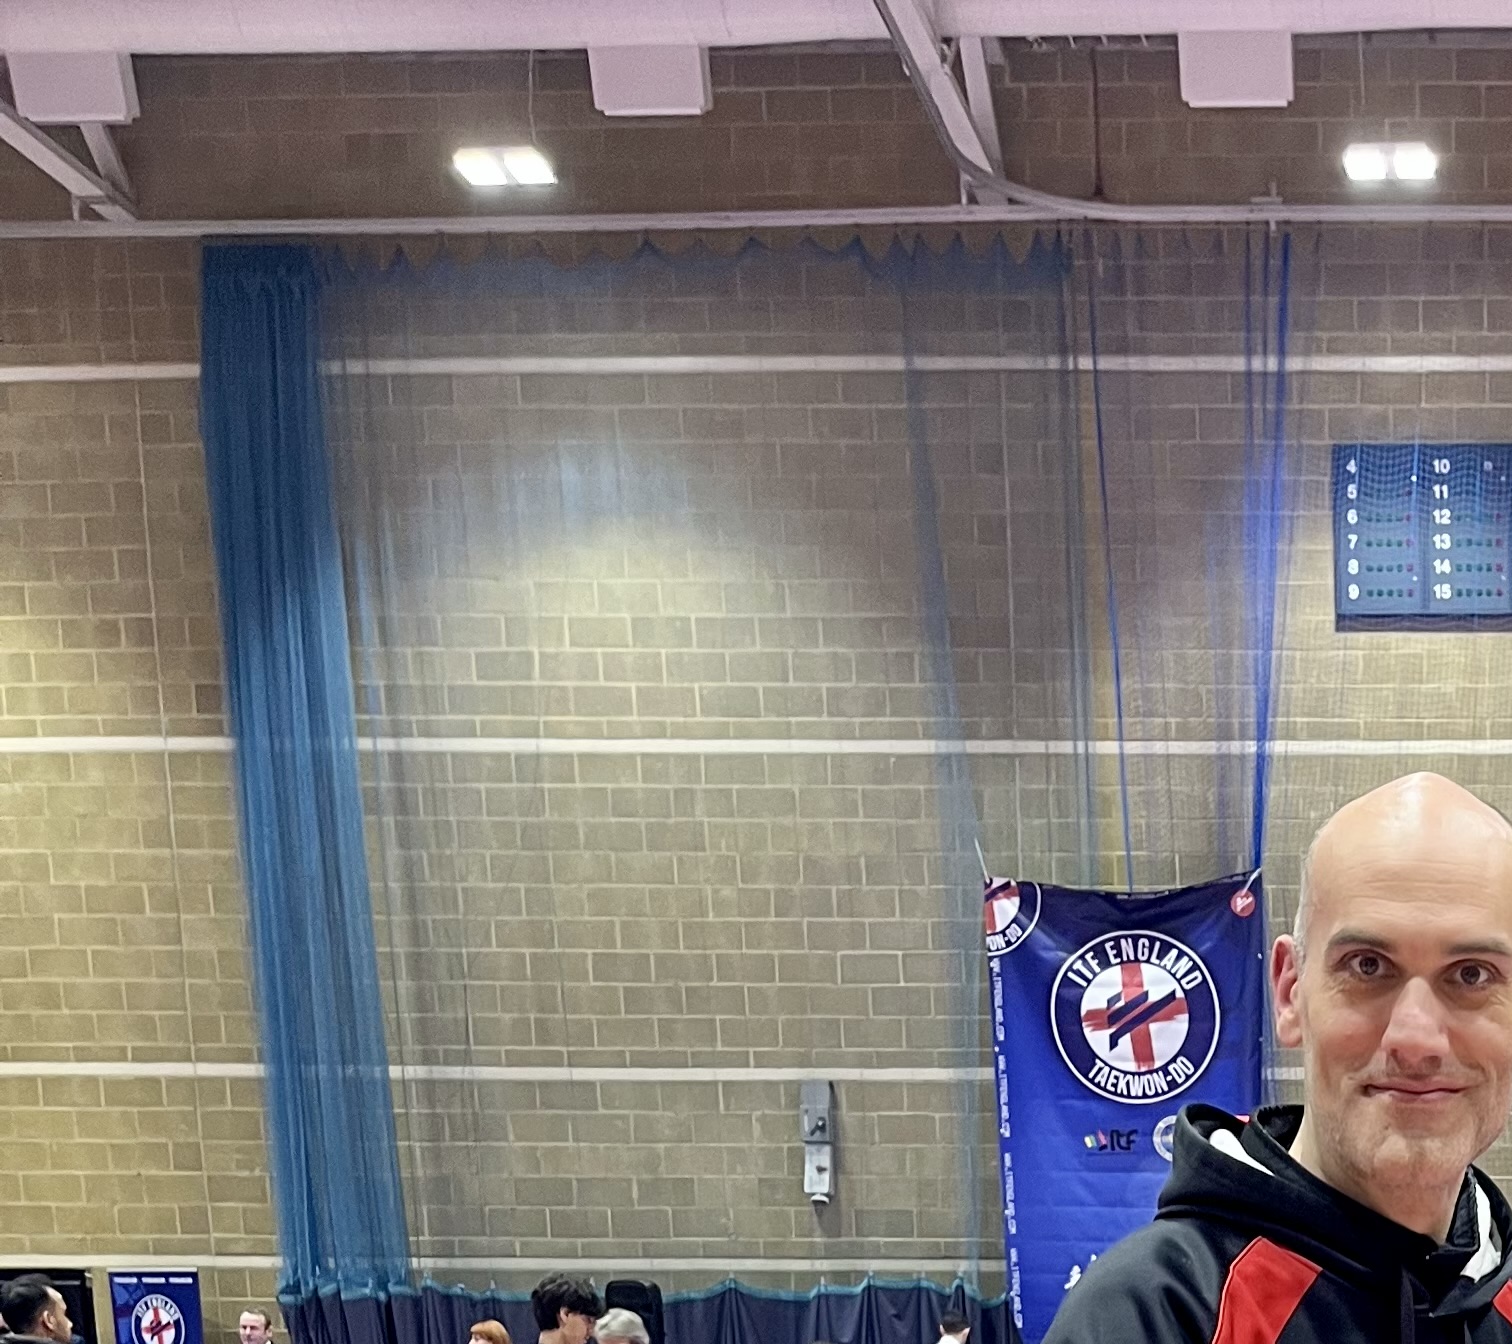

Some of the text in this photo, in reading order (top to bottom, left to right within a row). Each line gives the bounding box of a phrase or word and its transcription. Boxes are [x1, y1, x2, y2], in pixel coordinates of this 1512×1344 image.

[1346, 459, 1358, 473] 4
[1433, 459, 1450, 473] 10
[1347, 484, 1358, 499] 5
[1433, 484, 1449, 499] 11
[1347, 509, 1358, 524] 6
[1433, 509, 1451, 524] 12
[1348, 534, 1358, 550] 7
[1433, 534, 1451, 550] 13
[1348, 559, 1359, 575] 8
[1433, 559, 1451, 575] 14
[1348, 584, 1360, 600] 9
[1433, 584, 1452, 600] 15
[1066, 937, 1204, 992] ITF ENGLAND
[1087, 1055, 1196, 1098] TAEKWON-DO
